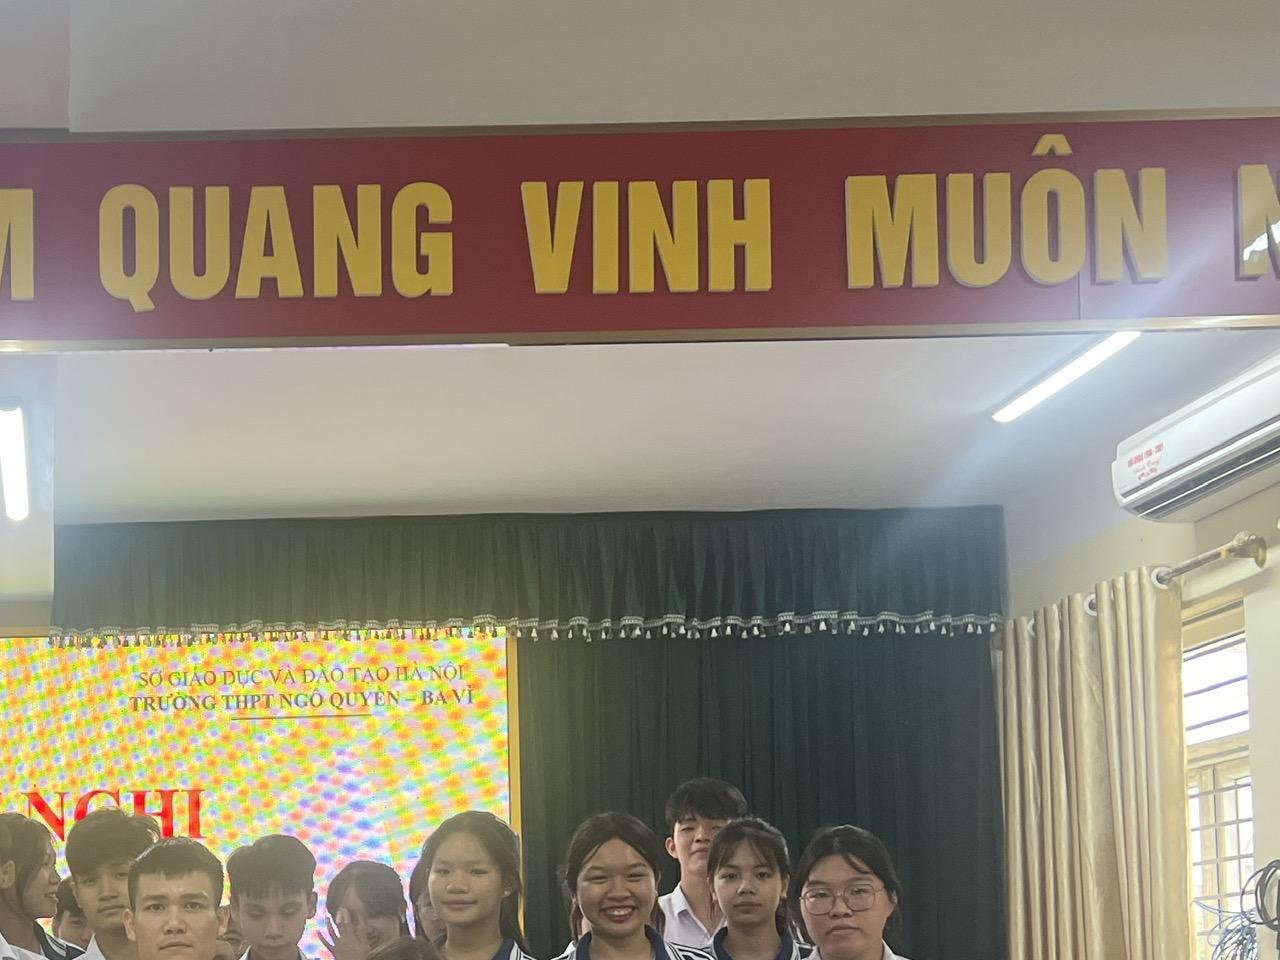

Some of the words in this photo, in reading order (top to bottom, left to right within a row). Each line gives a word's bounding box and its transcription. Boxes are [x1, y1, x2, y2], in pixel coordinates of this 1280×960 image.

[97, 181, 454, 313] QUANG
[520, 178, 772, 295] VINH
[845, 133, 1167, 290] MUÔN
[168, 667, 216, 687] GIÁO
[223, 670, 263, 688] DỤC
[269, 665, 296, 684] VÀ
[349, 667, 389, 684] TẠO
[395, 661, 422, 681] HÀ
[428, 661, 464, 682] NỘI
[129, 692, 216, 711] TRƯỜNG
[221, 693, 274, 710] THPT
[279, 688, 323, 709] NGÔ
[421, 690, 447, 705] BA
[452, 685, 473, 704] VÌ
